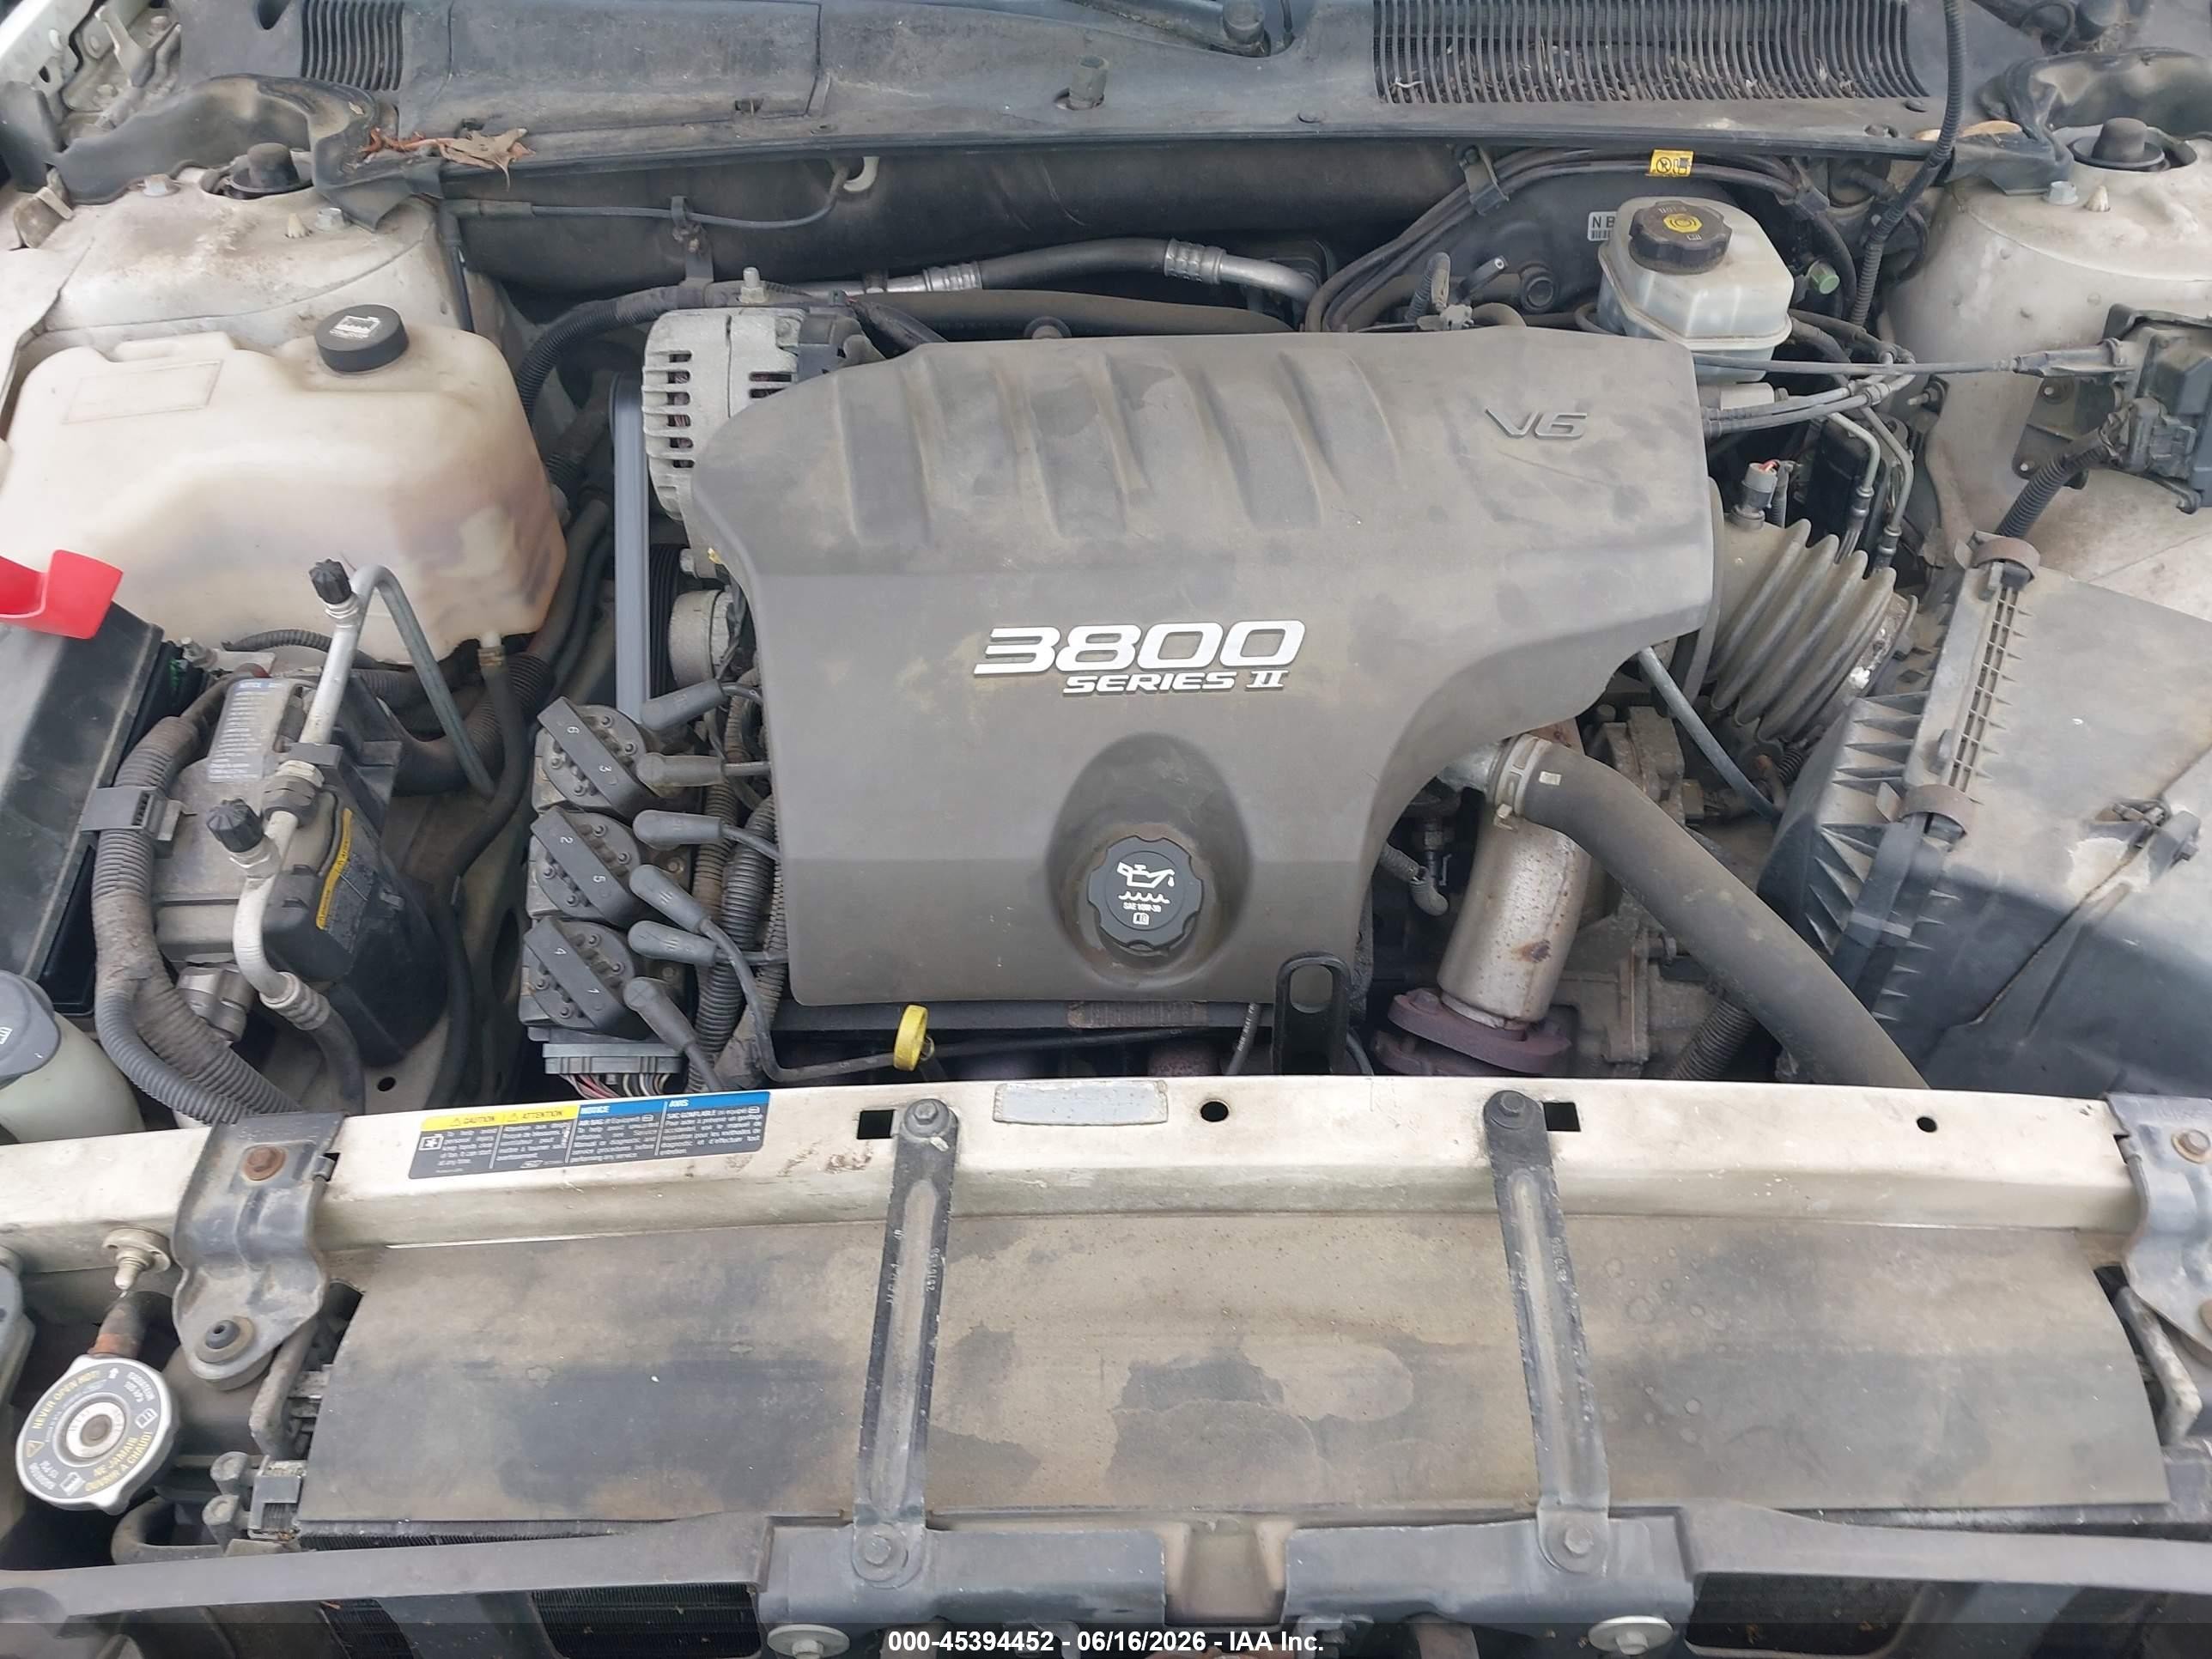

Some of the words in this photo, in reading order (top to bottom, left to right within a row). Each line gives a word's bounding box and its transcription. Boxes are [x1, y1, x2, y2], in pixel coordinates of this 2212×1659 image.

[1484, 408, 1588, 440] V6
[974, 620, 1306, 676] 3800
[1063, 671, 1237, 695] SERIES
[1245, 670, 1290, 690] II
[599, 764, 612, 773] 3
[560, 836, 574, 844] 2
[592, 874, 606, 883] 5
[554, 947, 567, 956] 4
[521, 1110, 563, 1120] ATTENTION
[32, 1400, 57, 1430] NEVER
[54, 1378, 79, 1402] OPEN
